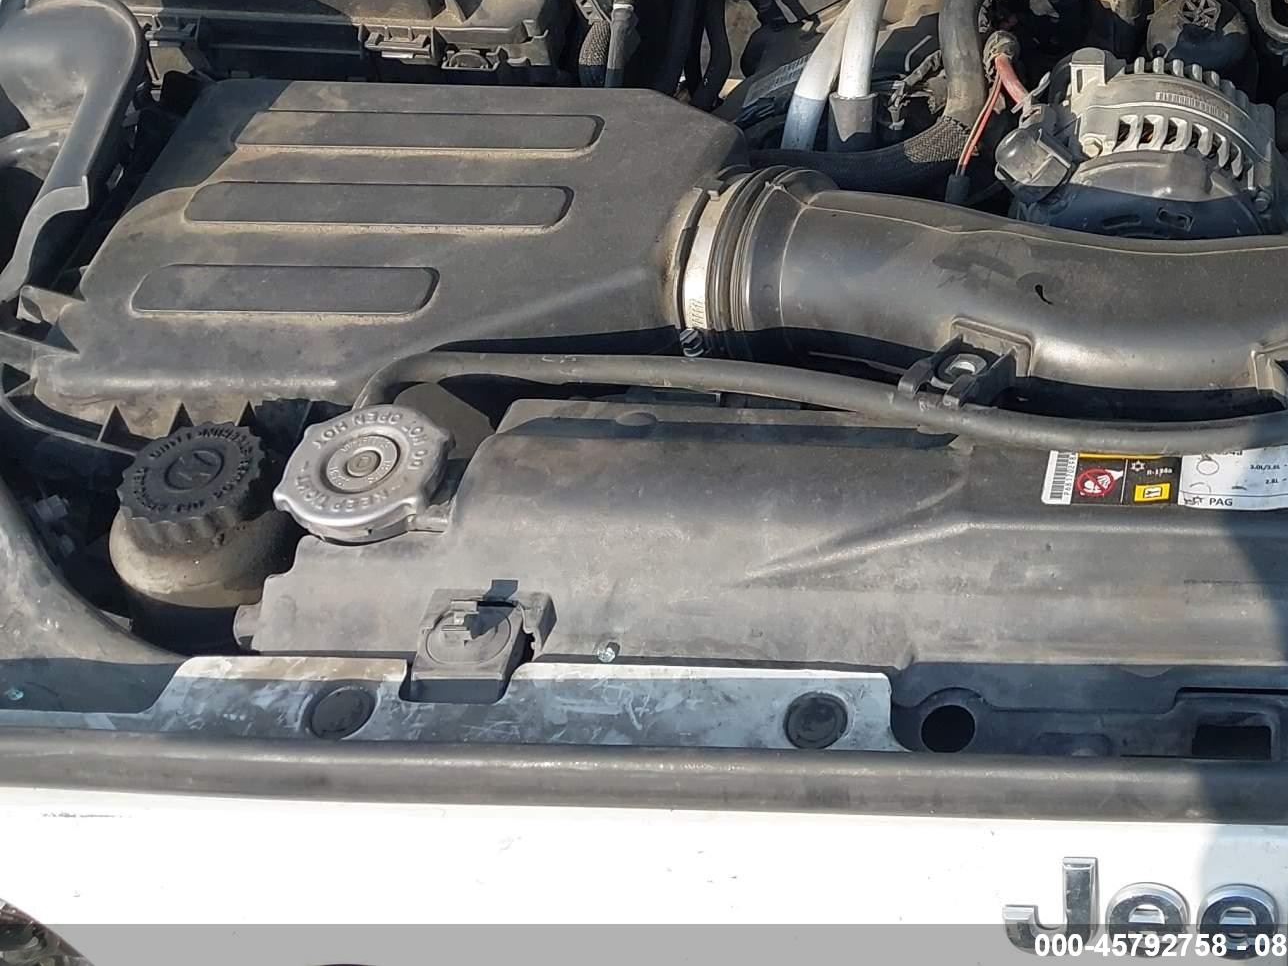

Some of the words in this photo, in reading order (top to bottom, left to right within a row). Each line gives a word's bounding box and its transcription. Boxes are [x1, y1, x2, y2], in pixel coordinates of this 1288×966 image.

[352, 411, 403, 427] OPEN
[312, 421, 349, 450] HOT
[1209, 498, 1233, 507] PAG
